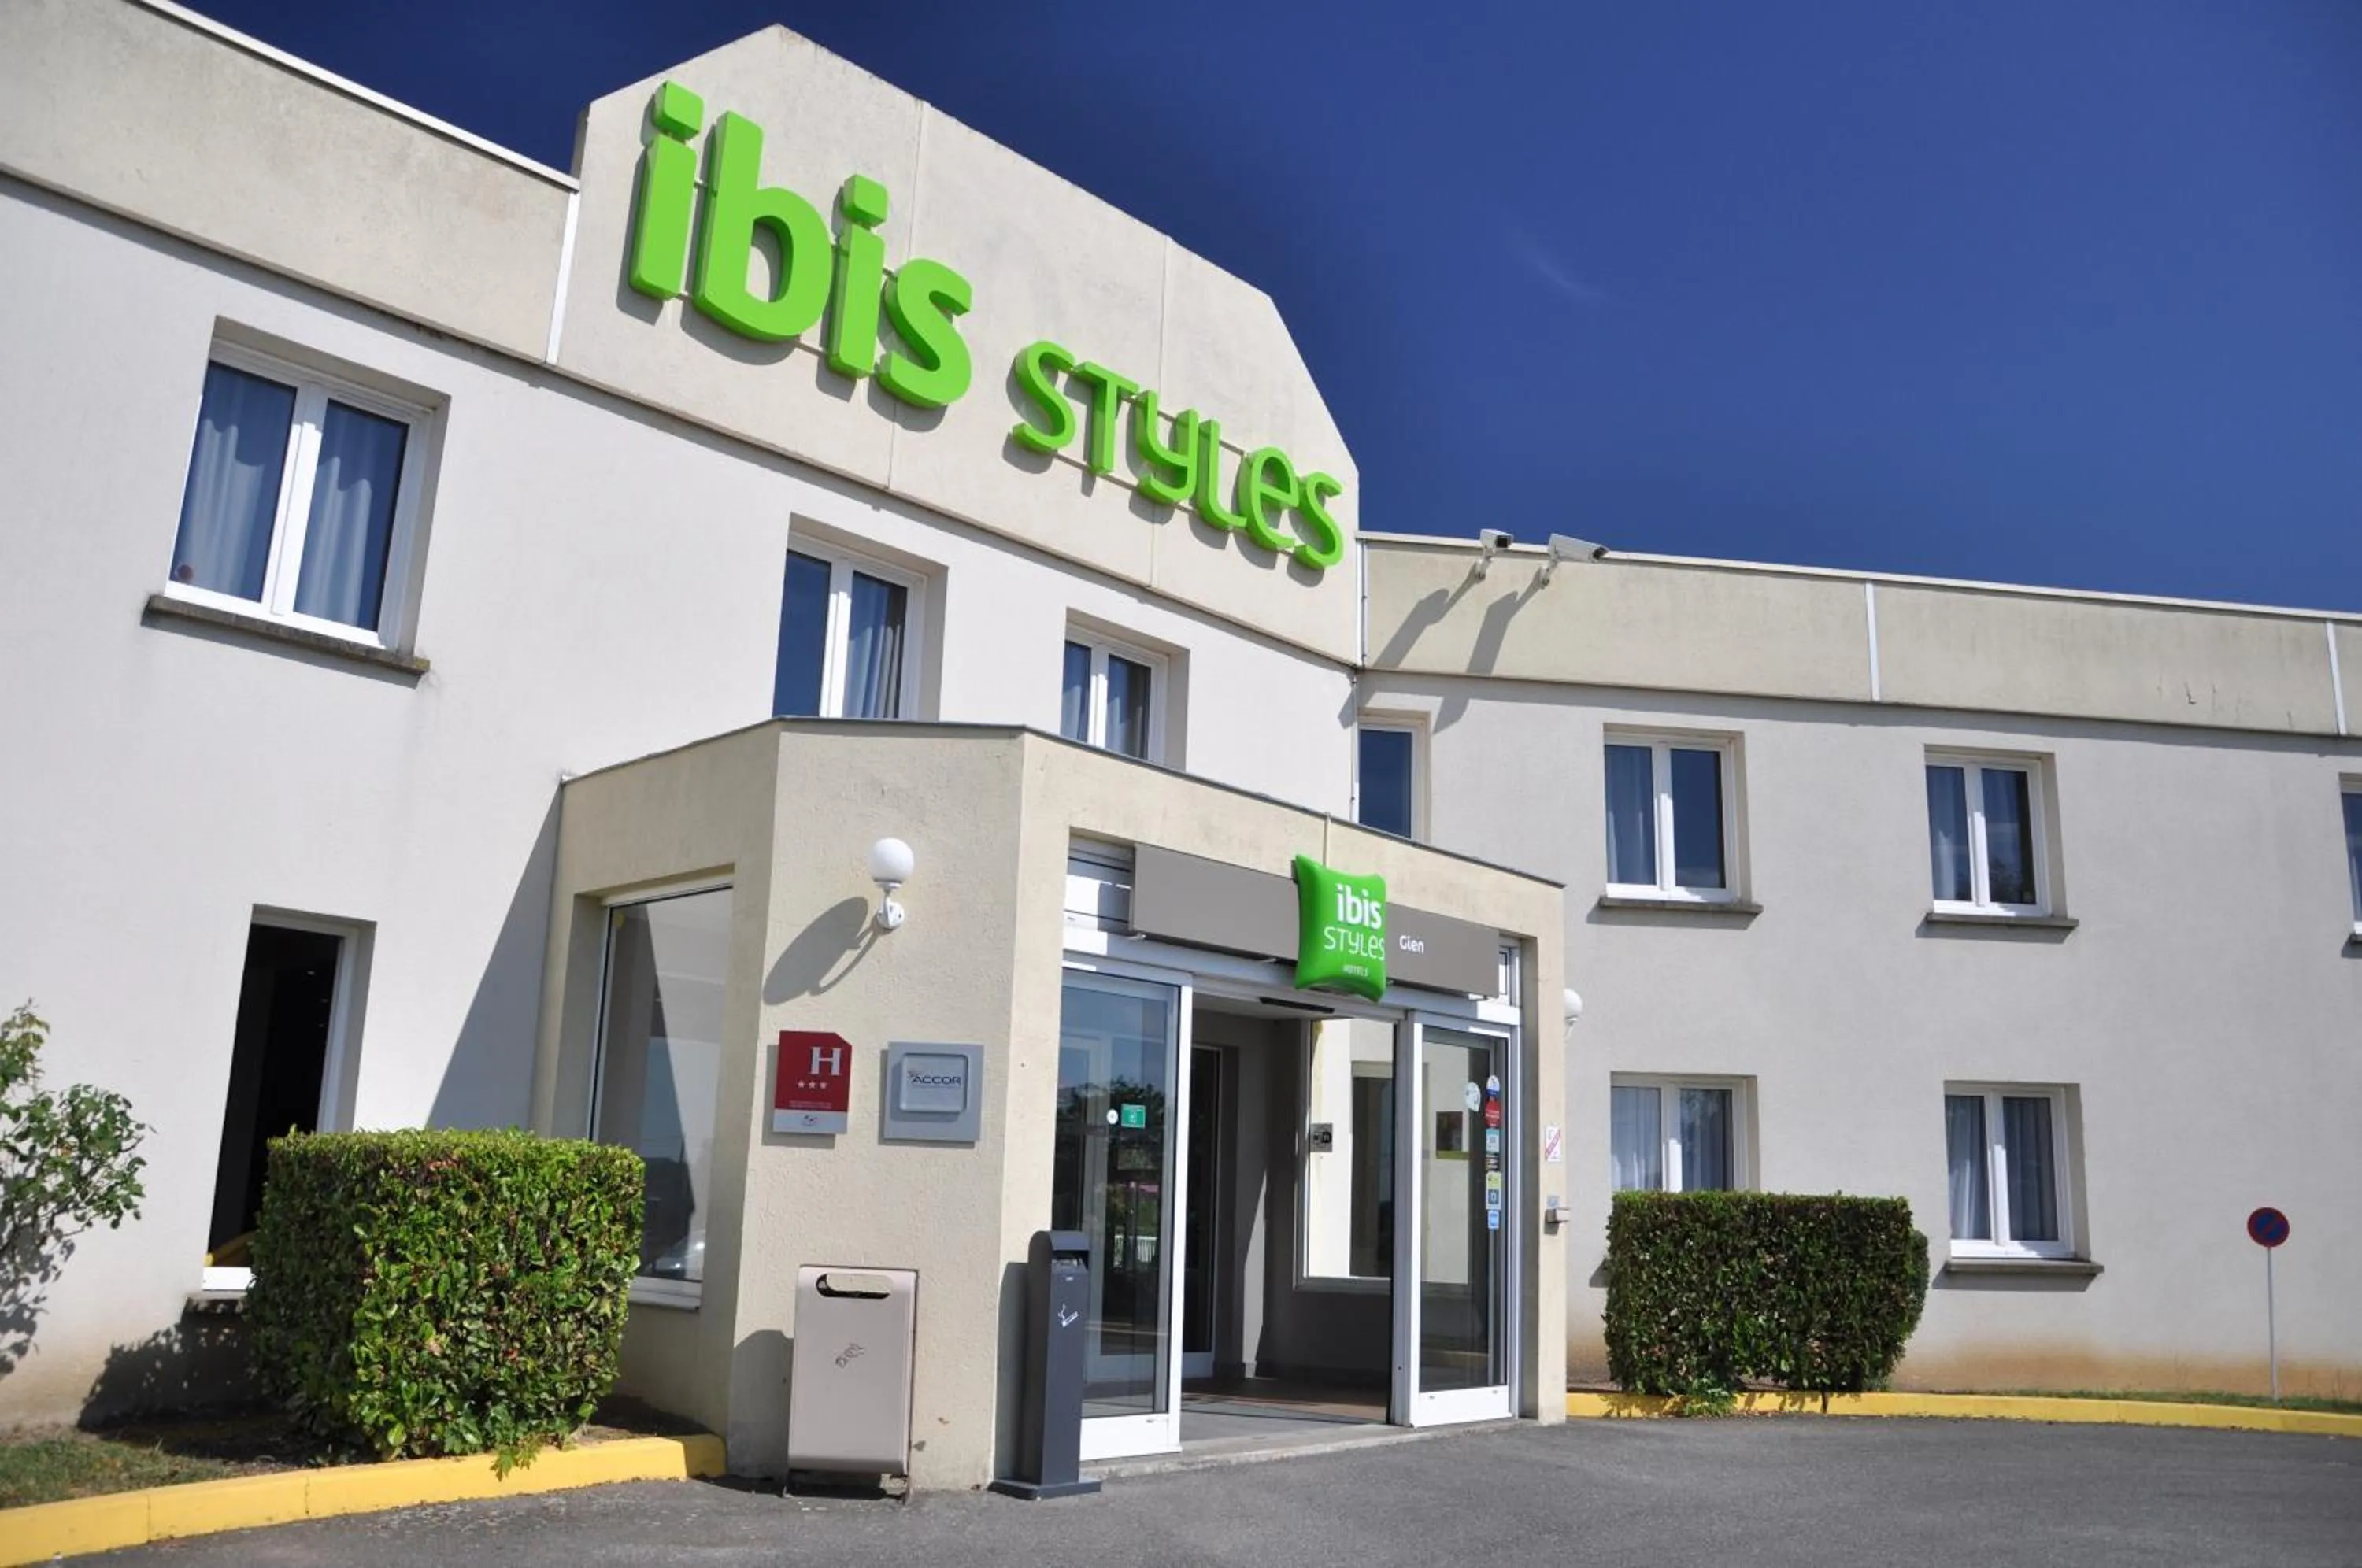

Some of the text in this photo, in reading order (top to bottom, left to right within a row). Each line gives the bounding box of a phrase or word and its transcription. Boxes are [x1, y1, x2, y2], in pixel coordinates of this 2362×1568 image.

[631, 80, 972, 409] ibis
[1336, 882, 1382, 929] ibis
[810, 1046, 842, 1075] H
[913, 1076, 961, 1085] ACCOR
